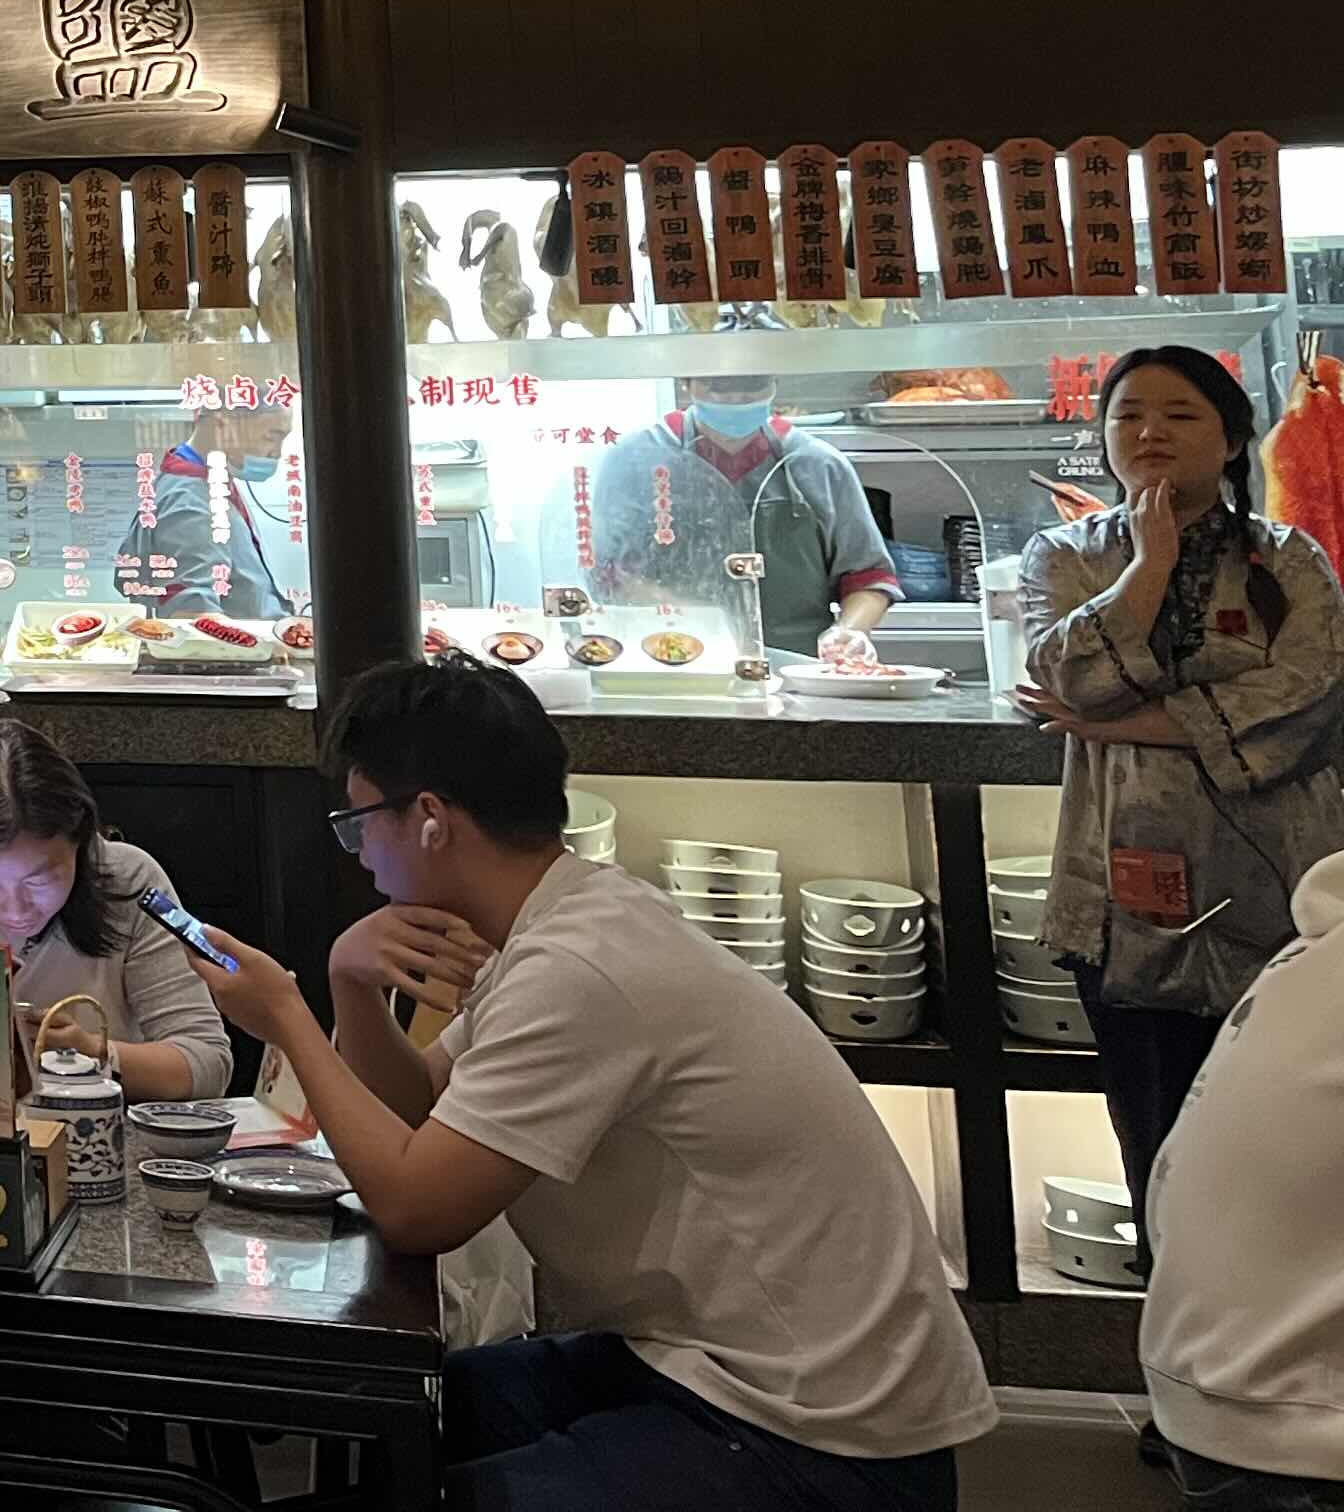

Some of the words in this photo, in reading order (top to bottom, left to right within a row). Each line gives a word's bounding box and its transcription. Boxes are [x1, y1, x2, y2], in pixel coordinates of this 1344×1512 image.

[582, 168, 624, 287] 冰鎮酒釀
[1082, 154, 1124, 278] 麻辣鴨血
